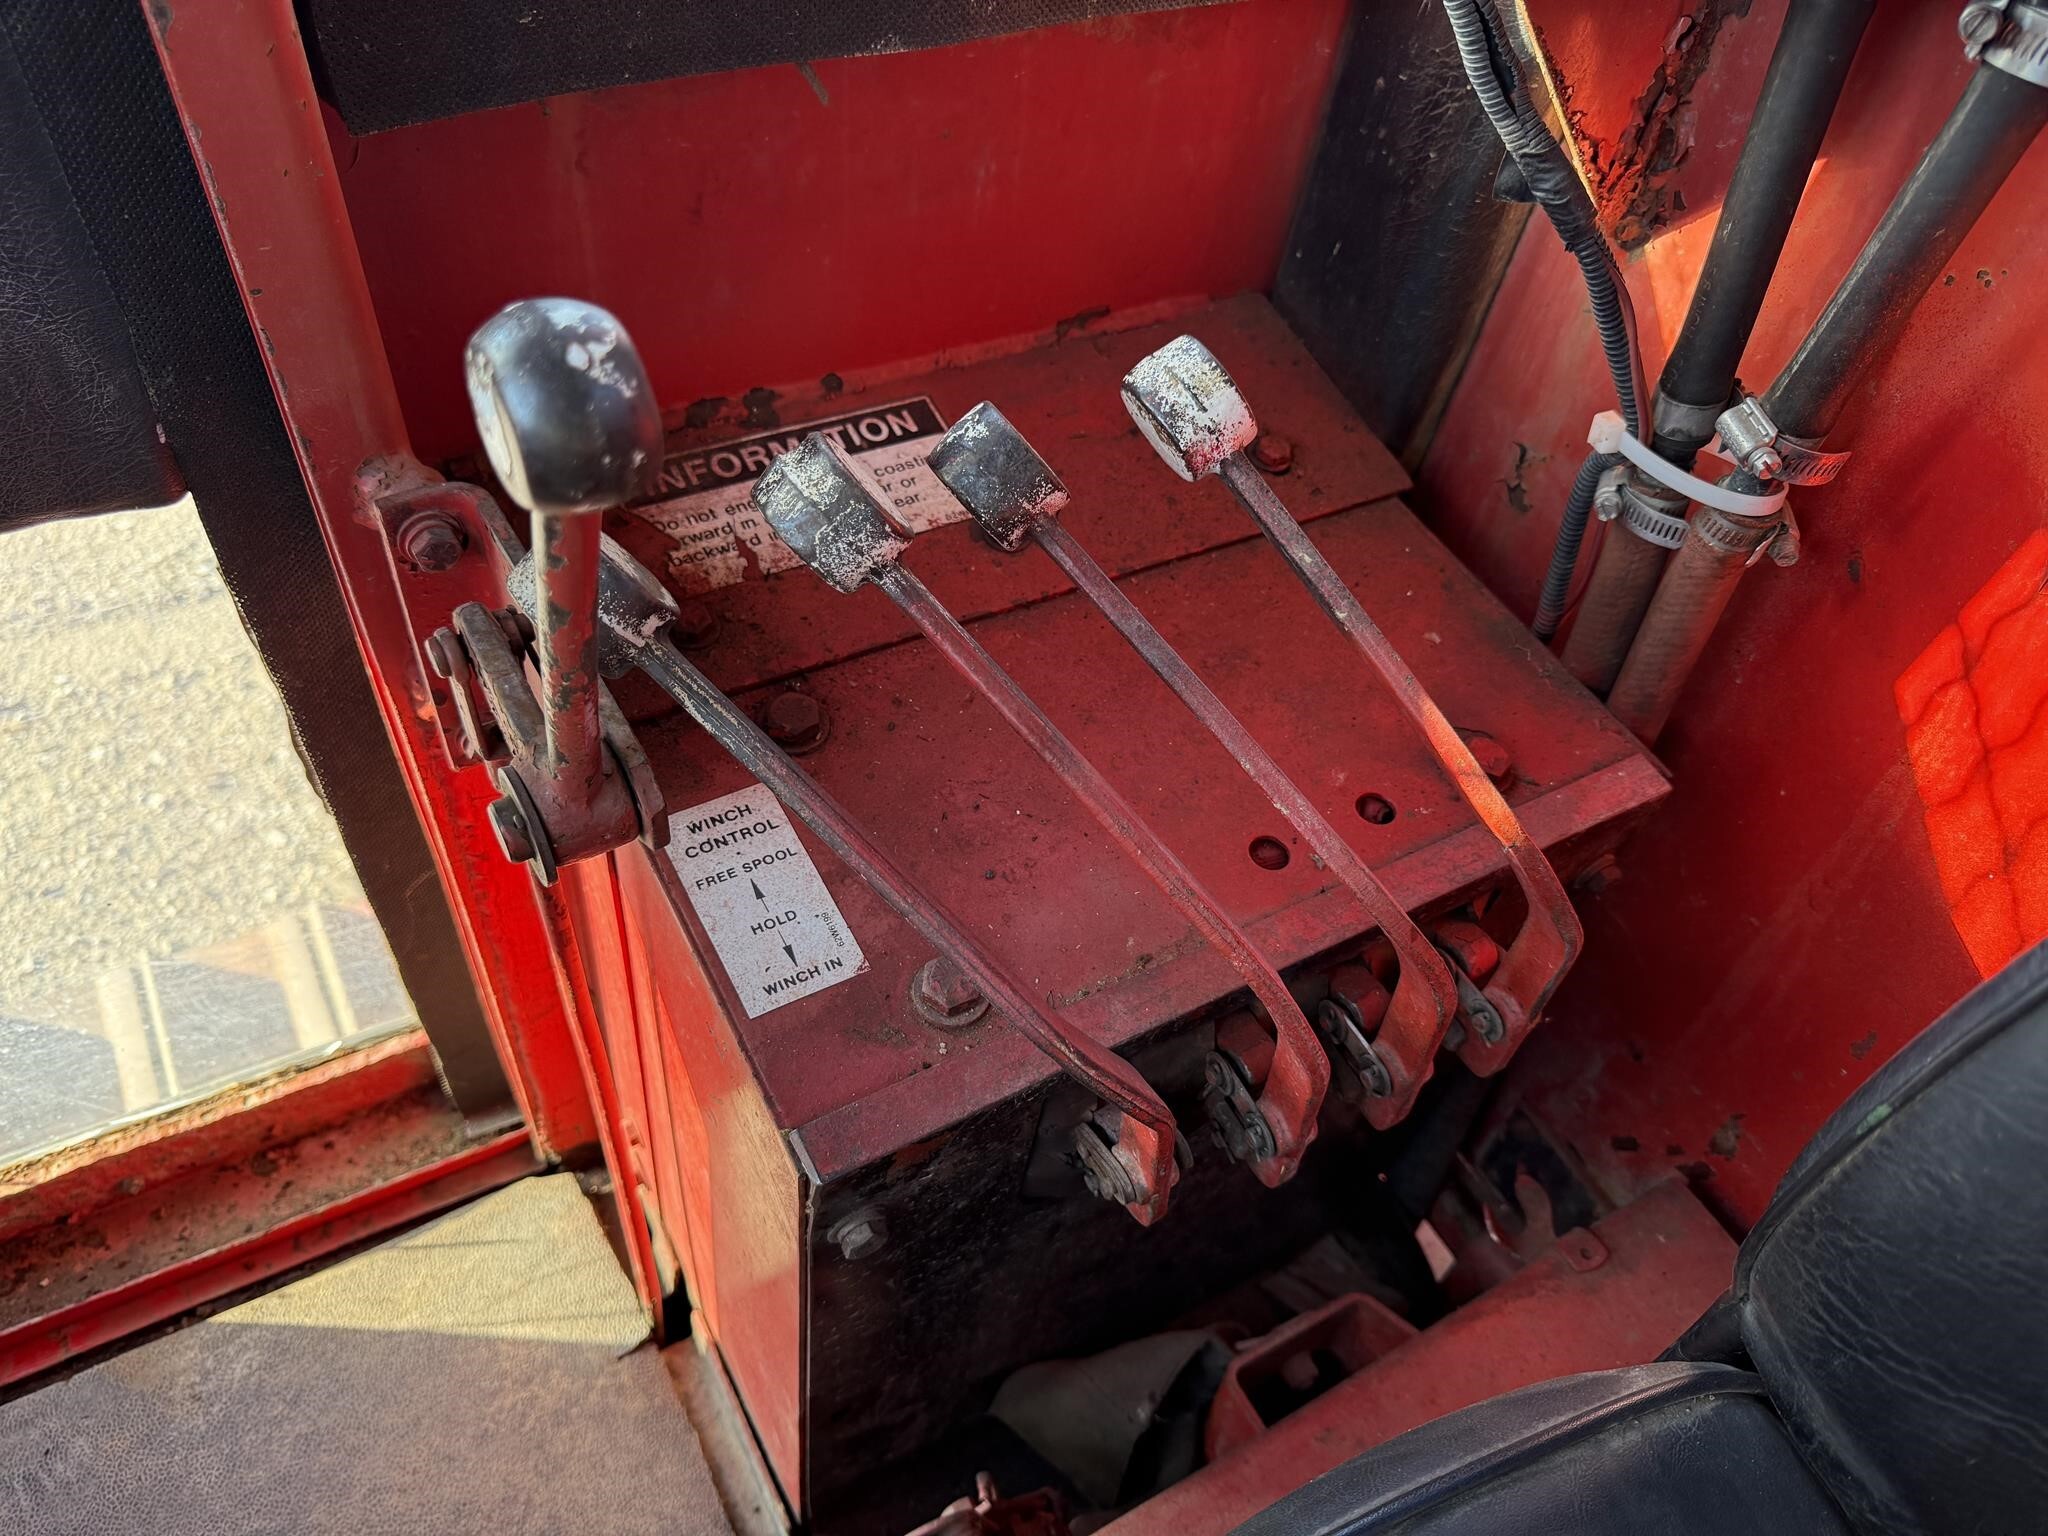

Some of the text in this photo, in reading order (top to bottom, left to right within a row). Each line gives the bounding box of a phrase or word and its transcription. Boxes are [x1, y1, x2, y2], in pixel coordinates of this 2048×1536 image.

[645, 410, 919, 498] INFORMTION
[900, 476, 917, 489] or
[686, 508, 718, 526] not
[686, 804, 753, 835] WINCH
[685, 818, 780, 859] CONTROL
[695, 846, 798, 891] FREE SPOOL
[750, 909, 798, 936] HOLD
[762, 956, 844, 997] WINCH IN
